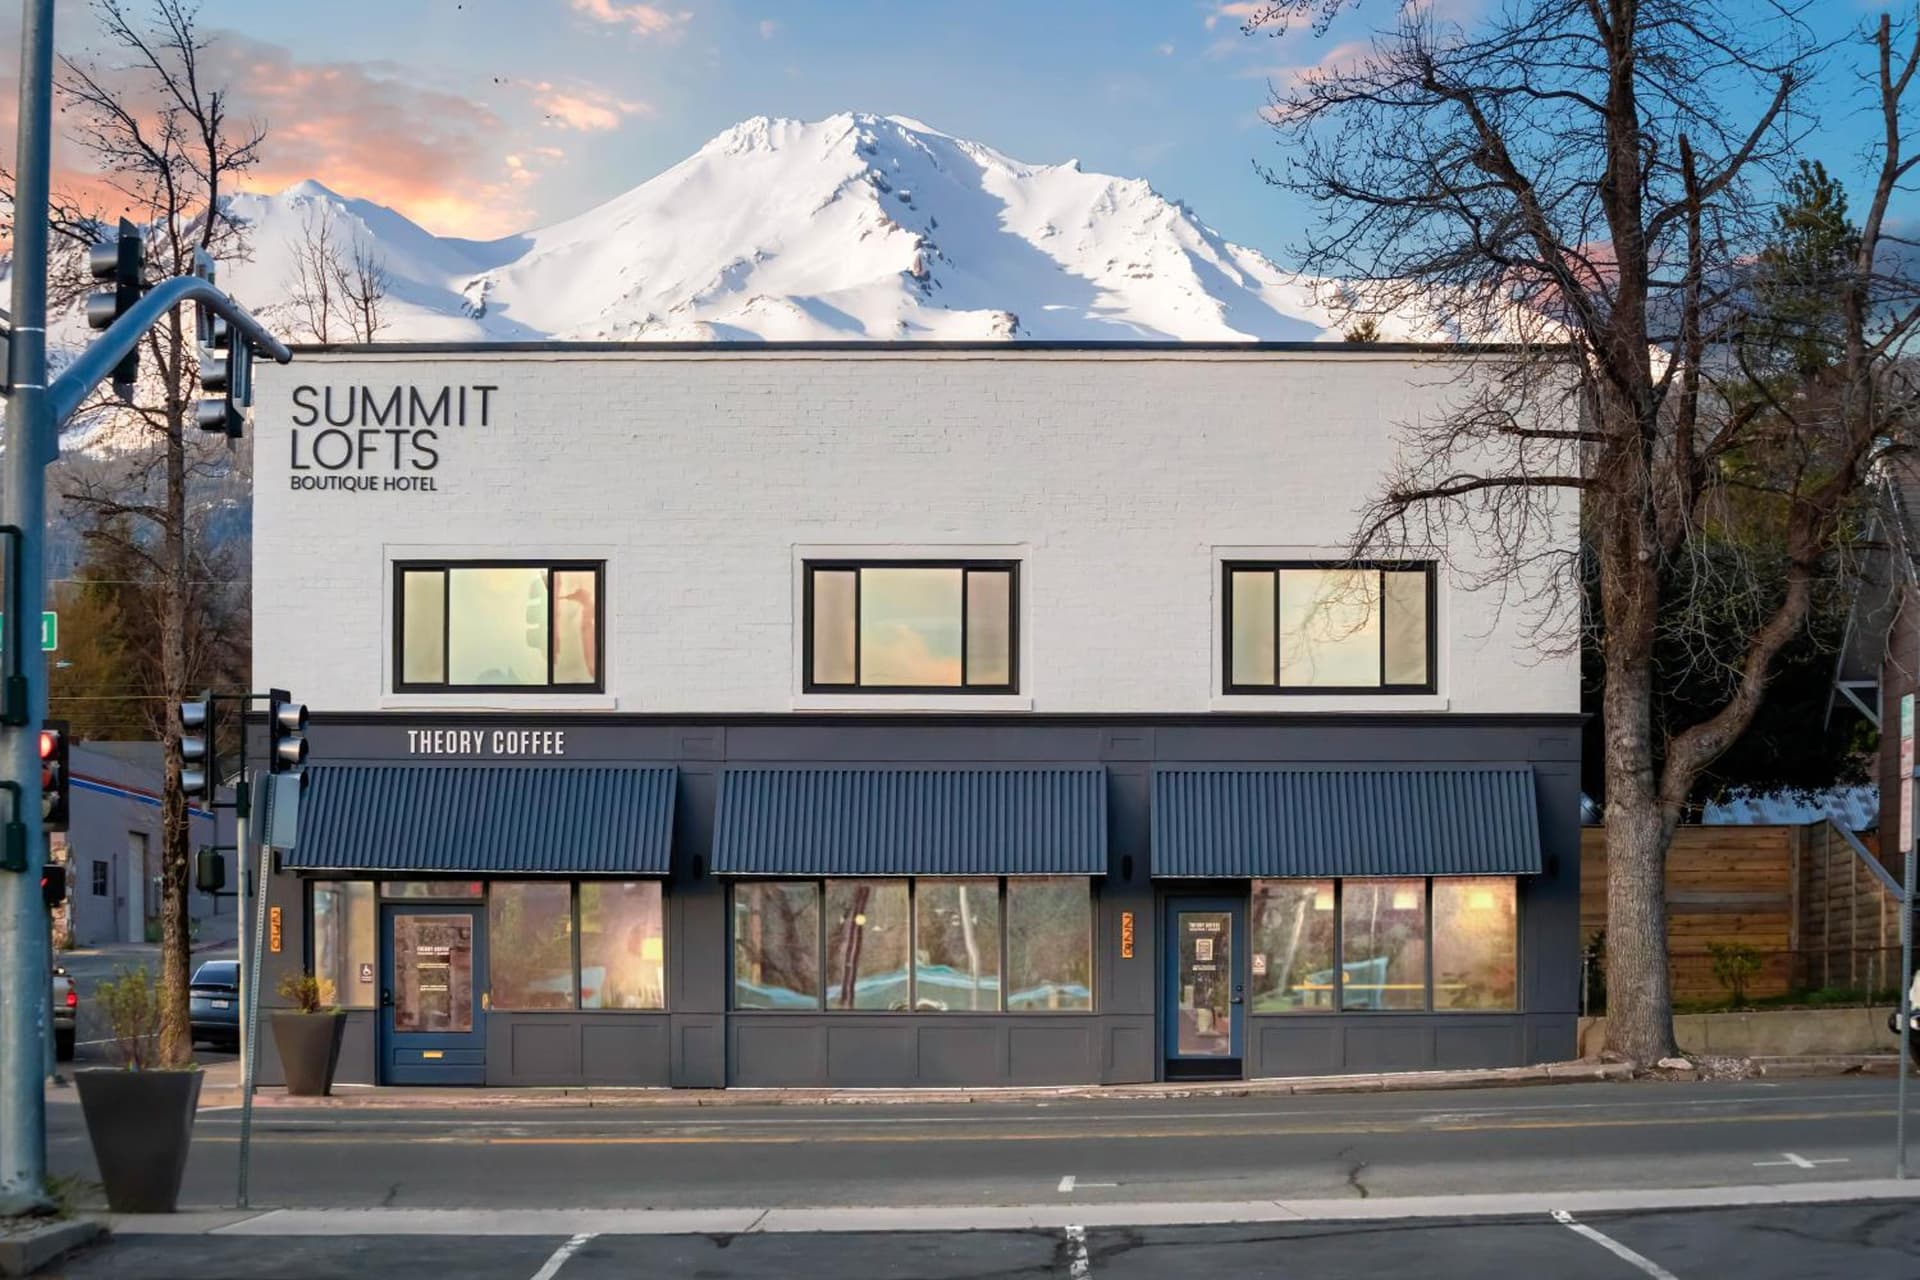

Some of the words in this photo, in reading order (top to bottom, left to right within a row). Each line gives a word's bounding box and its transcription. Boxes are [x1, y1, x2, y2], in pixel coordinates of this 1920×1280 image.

[292, 385, 499, 427] SUMMIT
[291, 428, 439, 470] LOFTS
[290, 475, 378, 493] BOUTIQUE
[383, 476, 438, 491] HOTEL
[407, 730, 485, 754] THEORY
[492, 730, 565, 755] COFFEE
